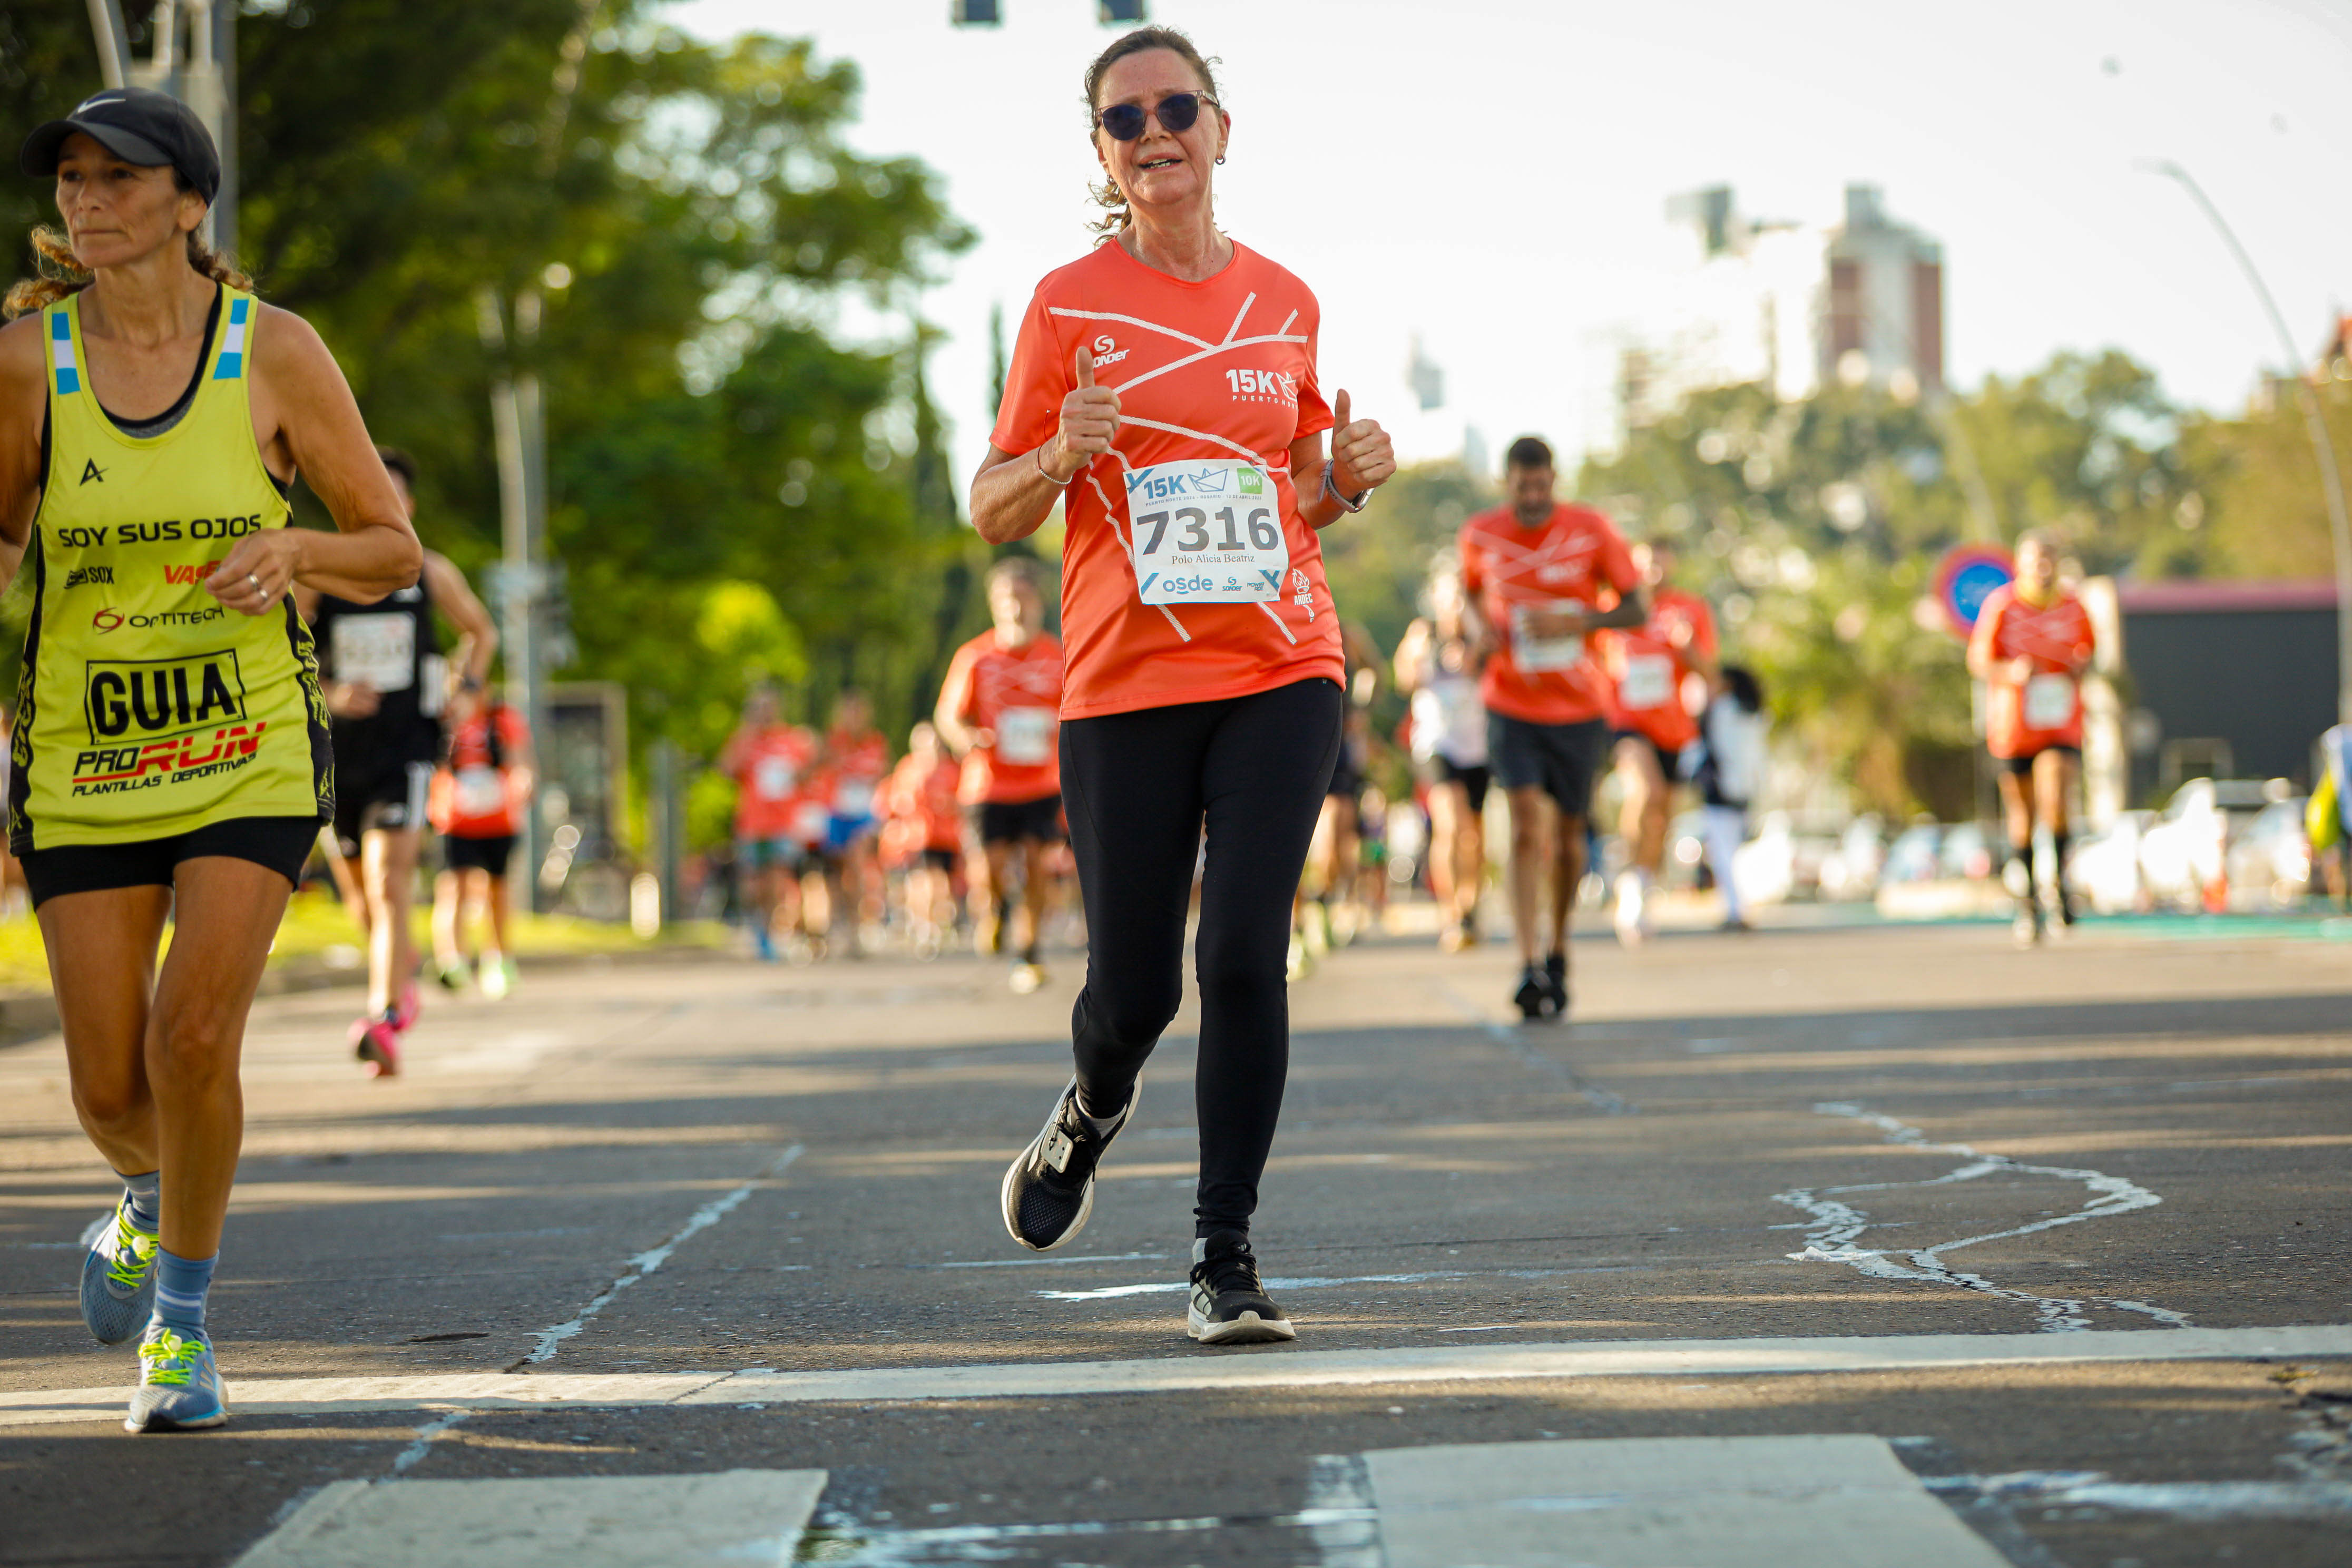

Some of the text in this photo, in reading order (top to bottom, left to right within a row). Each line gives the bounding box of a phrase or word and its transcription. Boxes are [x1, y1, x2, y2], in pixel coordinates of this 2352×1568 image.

[1092, 349, 1130, 368] ONDer
[1226, 369, 1278, 395] 15K
[1232, 395, 1299, 410] PUERTO NORT
[1143, 474, 1187, 499] 15K
[1240, 475, 1261, 486] 10K
[58, 514, 261, 547] SOY SUS OJOS
[1136, 506, 1279, 555] 7316
[1171, 553, 1255, 564] Polo Alicia Beatriz
[1163, 574, 1213, 592] osde
[1294, 593, 1313, 605] ARDEC
[91, 663, 237, 736] GUIA
[72, 751, 257, 797] PLANTILLAS DEPORTIVAS
